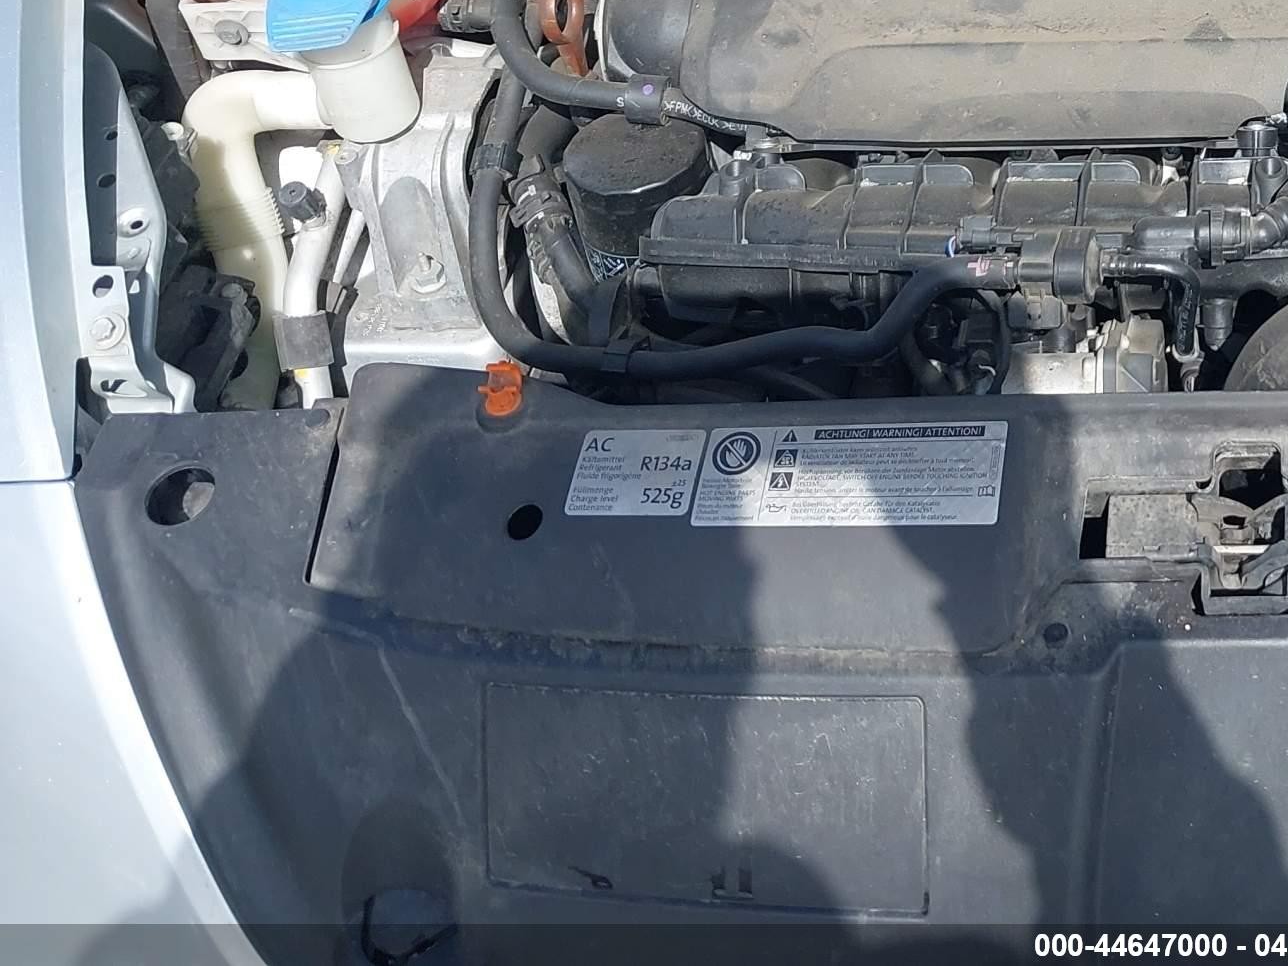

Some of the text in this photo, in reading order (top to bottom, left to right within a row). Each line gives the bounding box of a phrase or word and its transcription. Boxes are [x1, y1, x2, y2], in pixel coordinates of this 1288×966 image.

[819, 427, 982, 439] ACHTUNG! WARNING! ATTENTION!
[585, 437, 615, 452] AC
[640, 456, 692, 471] R134a
[570, 495, 599, 504] Charge
[640, 487, 684, 509] 525g
